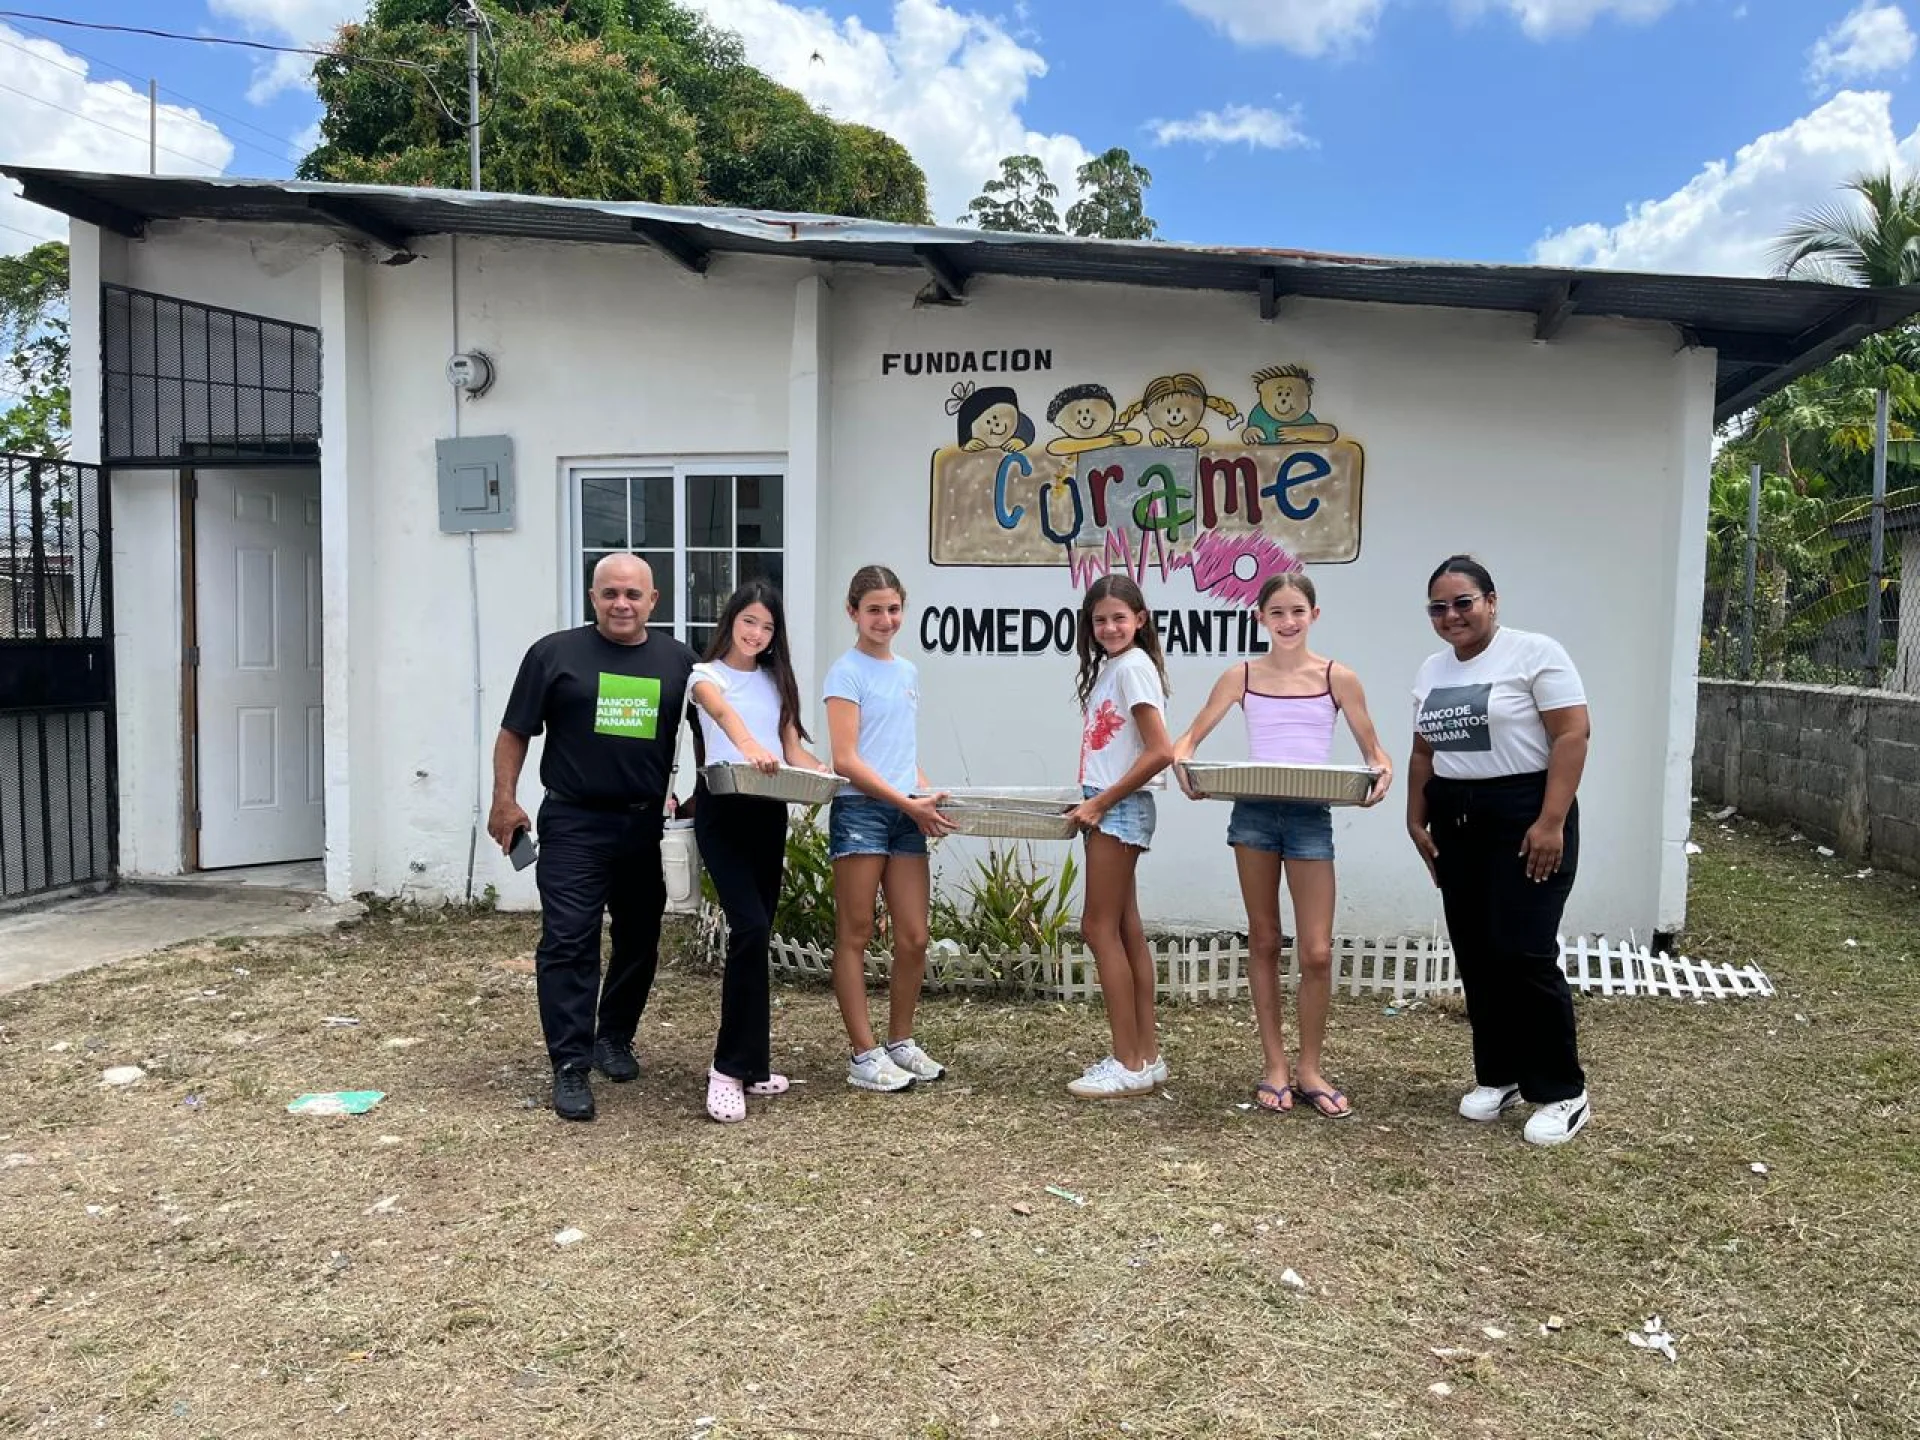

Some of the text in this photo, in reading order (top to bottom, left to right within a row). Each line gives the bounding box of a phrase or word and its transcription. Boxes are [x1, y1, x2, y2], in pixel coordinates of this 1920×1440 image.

[881, 349, 1053, 376] FUNDACION
[919, 605, 1270, 654] COMEDO FANTIL
[634, 698, 648, 706] DE
[1455, 704, 1471, 716] DE
